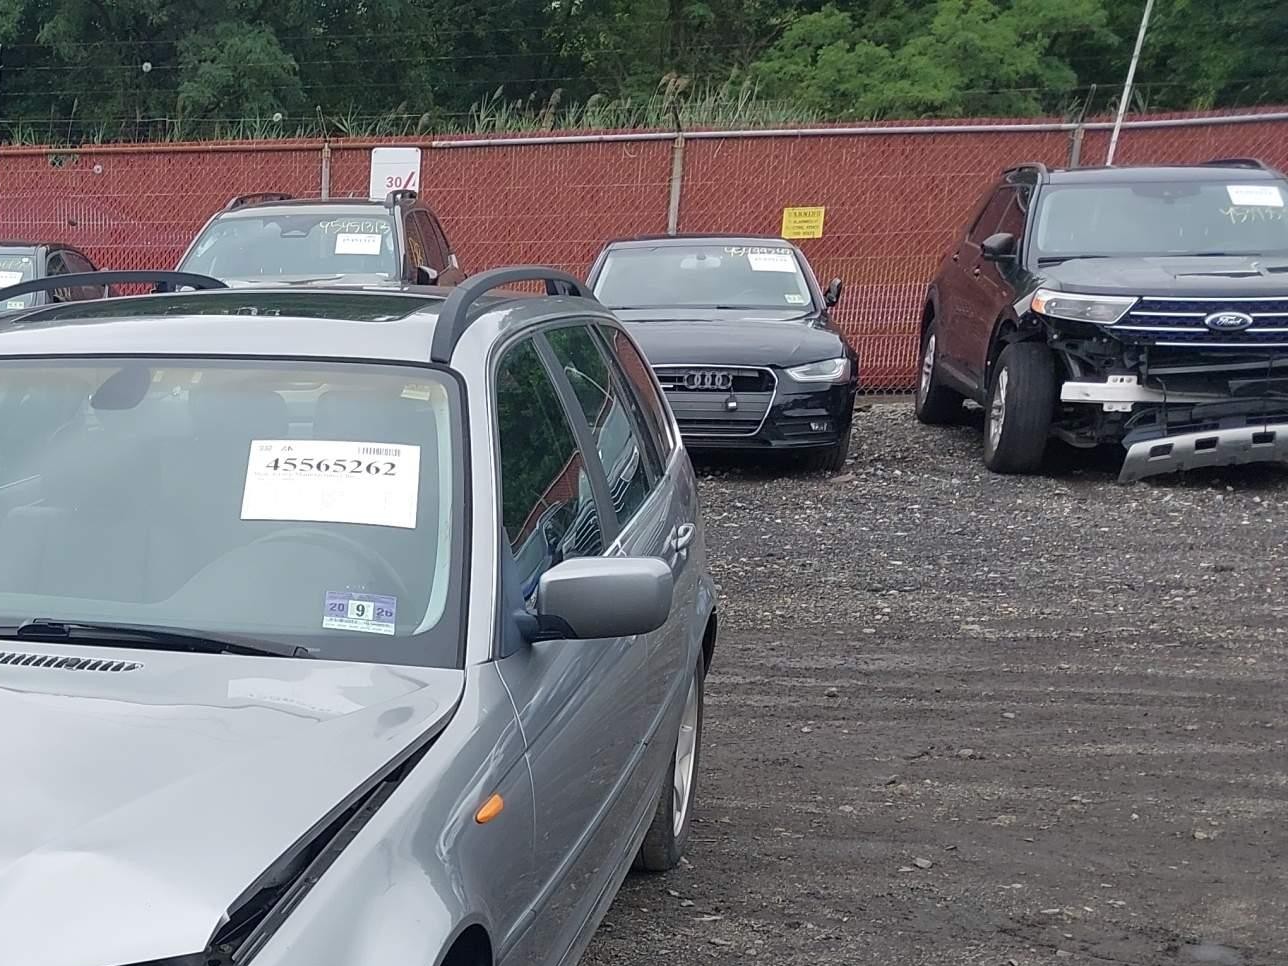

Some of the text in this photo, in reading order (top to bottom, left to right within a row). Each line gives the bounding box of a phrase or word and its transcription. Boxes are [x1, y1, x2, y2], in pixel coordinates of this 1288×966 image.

[1215, 315, 1243, 326] Ford
[265, 457, 397, 477] 45565262
[329, 602, 345, 612] 20
[356, 603, 365, 617] 9
